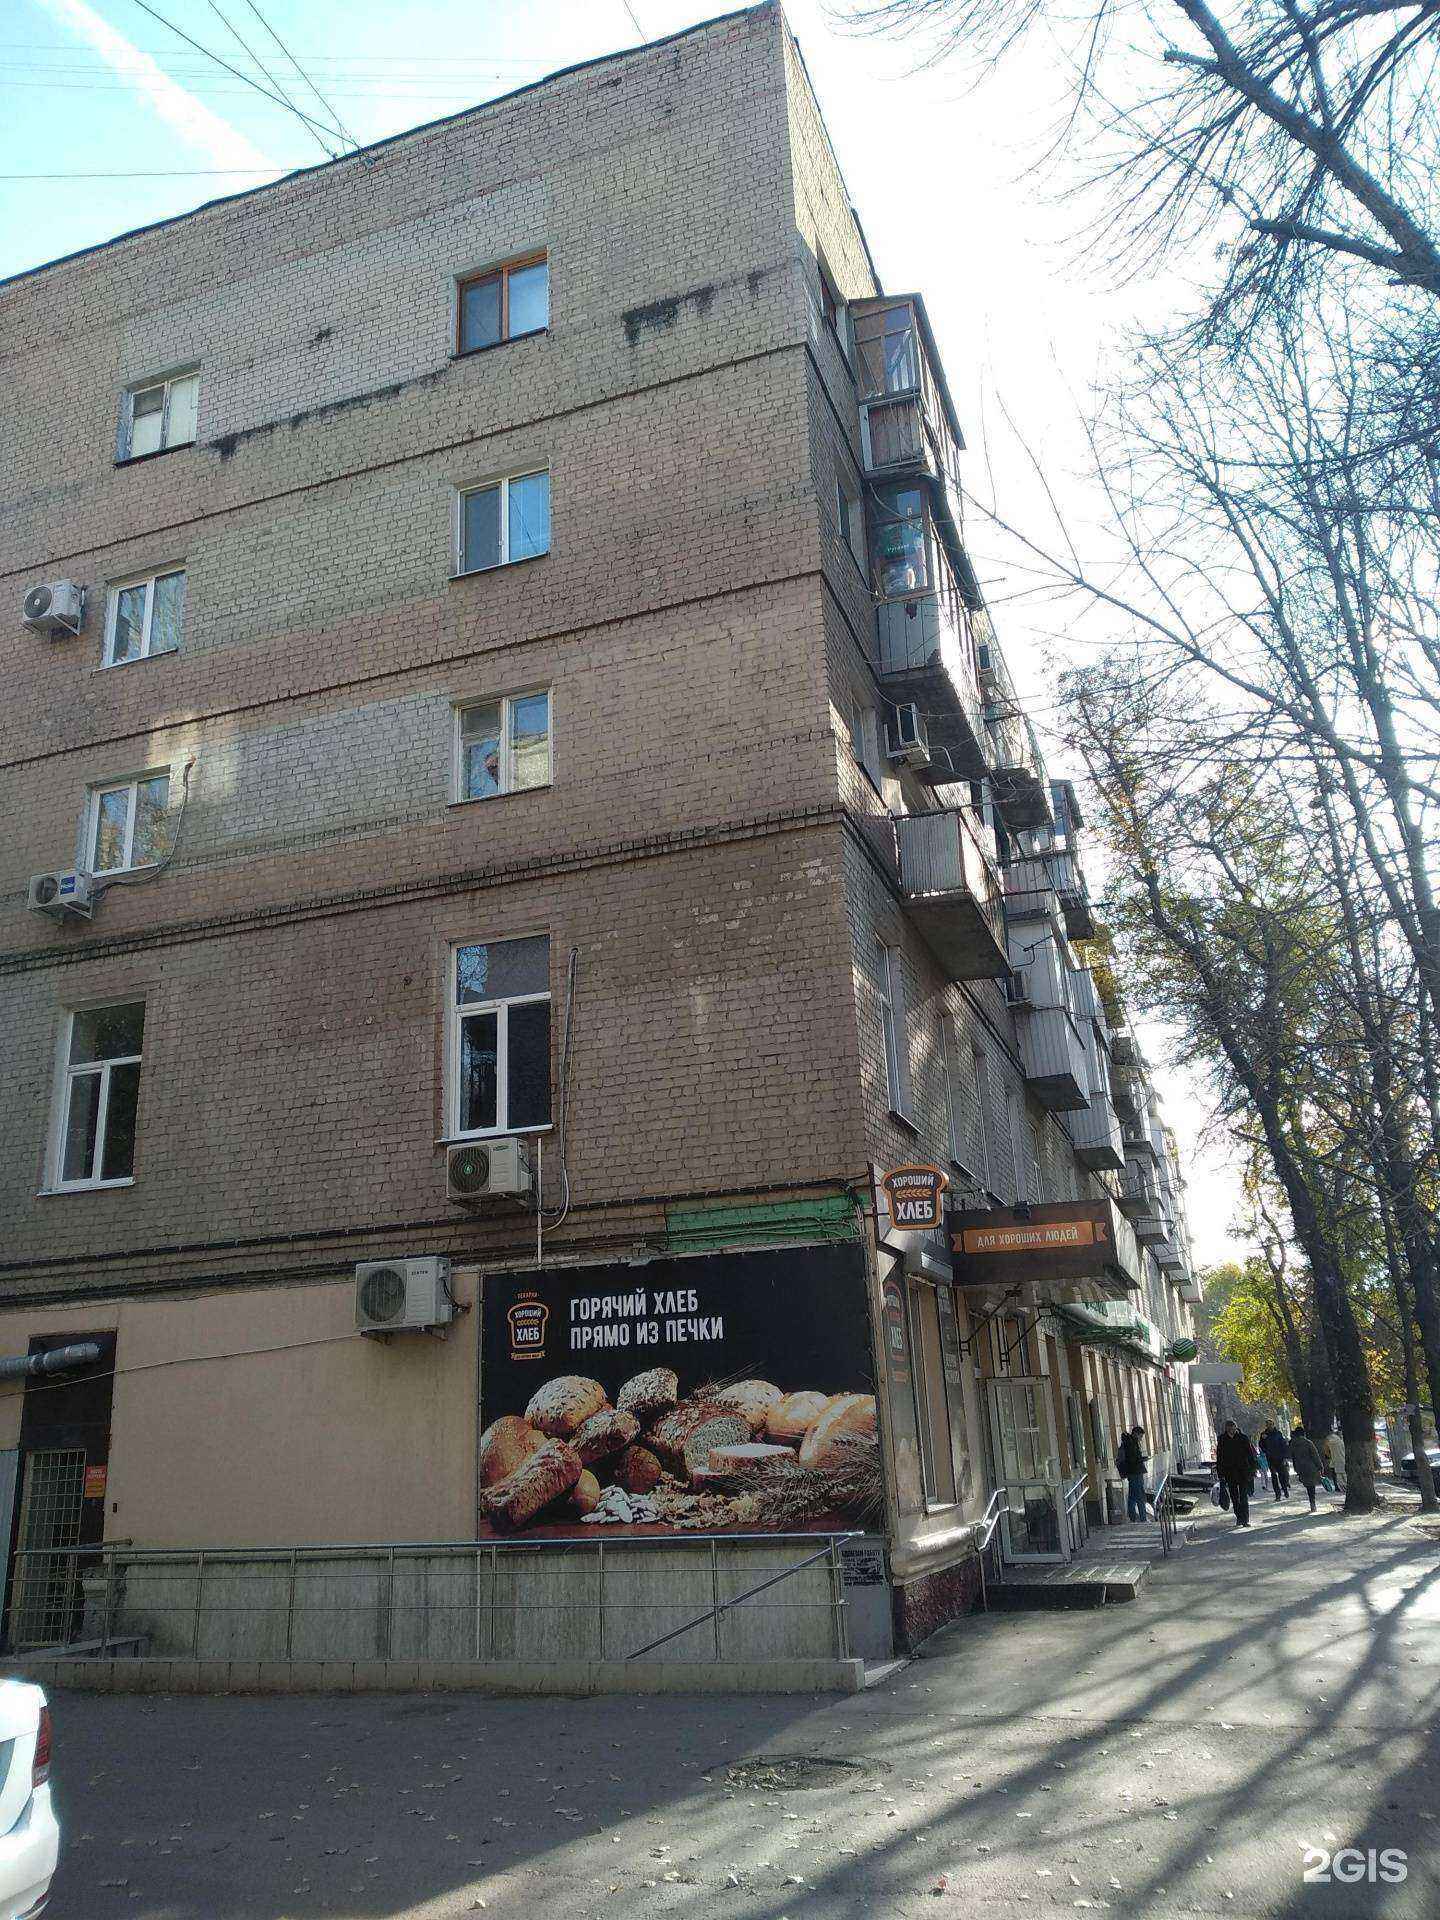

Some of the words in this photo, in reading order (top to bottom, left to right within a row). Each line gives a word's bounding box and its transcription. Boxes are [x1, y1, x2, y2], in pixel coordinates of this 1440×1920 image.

[891, 1174, 934, 1188] ХОРОШИЙ
[896, 1200, 933, 1220] ХЛЕБ
[977, 1235, 995, 1248] ДЛЯ
[999, 1231, 1041, 1245] ХОРОШИХ
[1045, 1226, 1079, 1241] ЛЮДЕЙ
[570, 1288, 647, 1321] ГОРЯЧИЙ
[653, 1289, 698, 1315] ХЛЕБ
[516, 1327, 540, 1342] ХЛЕБ
[570, 1324, 630, 1350] ПРЯМО
[636, 1322, 659, 1345] ИЗ
[666, 1316, 724, 1342] ПЕЧКИ
